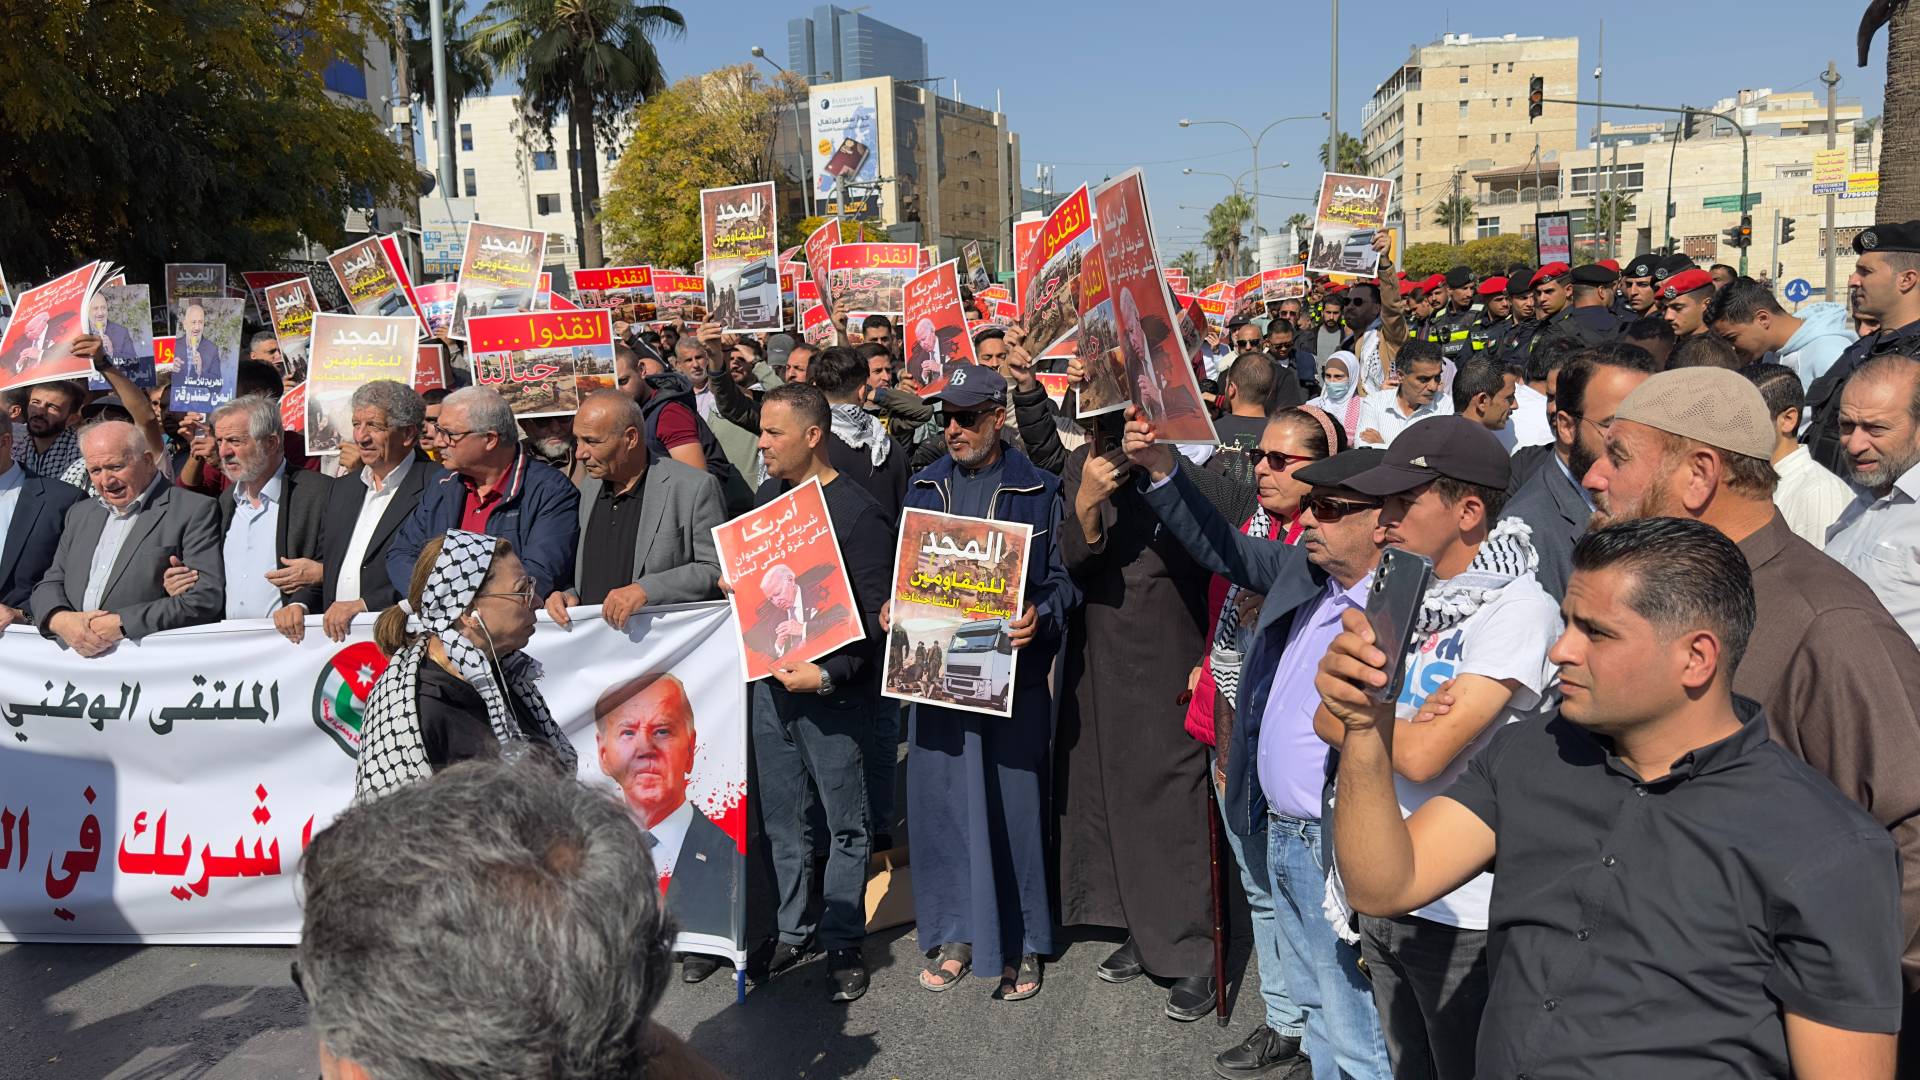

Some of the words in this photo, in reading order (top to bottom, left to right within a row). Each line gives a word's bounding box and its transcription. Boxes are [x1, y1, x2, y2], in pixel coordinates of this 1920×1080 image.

[1334, 183, 1379, 202] المجد
[716, 192, 761, 226] المجد
[712, 226, 766, 248] للمقاومين
[1043, 195, 1085, 258] انقذوا
[482, 235, 532, 256] المجد
[866, 247, 912, 268] انقذوا
[342, 246, 376, 277] المجد
[471, 259, 531, 273] للمقاومين
[606, 269, 648, 289] انقذوا
[911, 269, 941, 298] أمريكا
[275, 286, 305, 310] المجد
[332, 324, 398, 351] المجد
[529, 315, 602, 348] انقذوا
[322, 353, 402, 369] للمقاومين
[476, 352, 560, 394] جبالنا
[741, 493, 798, 543] أمريكا
[787, 513, 819, 537] شريك
[775, 531, 785, 551] في
[787, 536, 805, 553] غزة
[808, 526, 829, 545] على
[735, 538, 772, 567] العدوان
[760, 549, 786, 571] وعلى
[922, 531, 1003, 566] المجد
[730, 561, 757, 583] لبنان
[910, 568, 1006, 594] للمقاومين
[901, 591, 960, 609] الشاحنات
[962, 600, 1011, 620] وسائقي
[0, 679, 142, 742] الوطني
[149, 674, 280, 735] الملتقى
[45, 785, 101, 922] في
[118, 783, 282, 901] شريك
